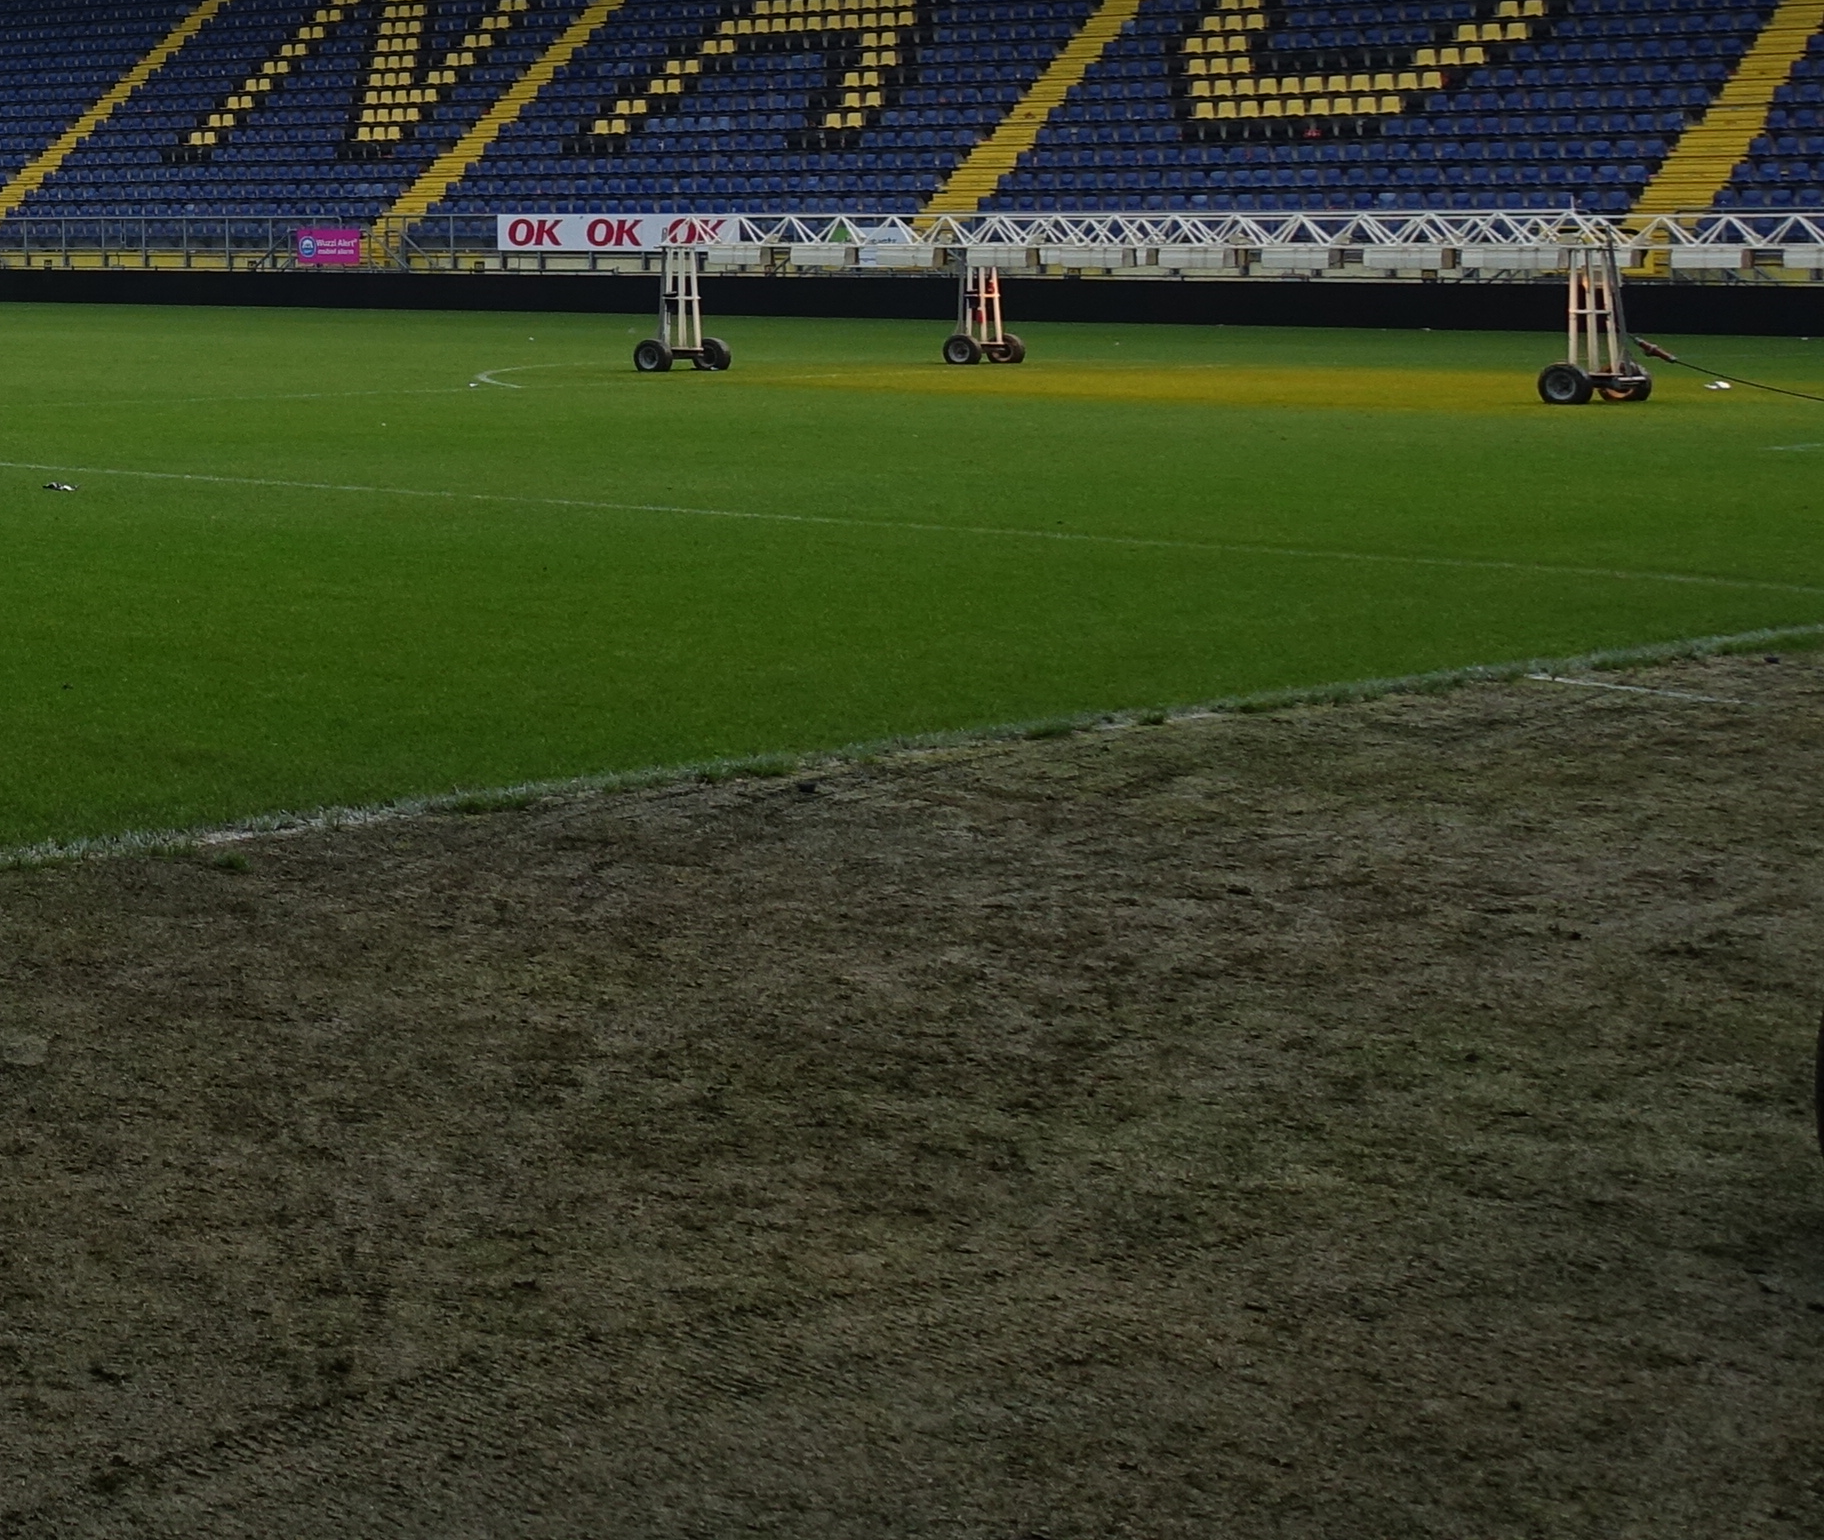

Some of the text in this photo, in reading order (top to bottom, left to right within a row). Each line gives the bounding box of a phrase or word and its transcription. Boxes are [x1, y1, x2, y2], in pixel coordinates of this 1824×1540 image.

[508, 219, 728, 247] OK OK OK
